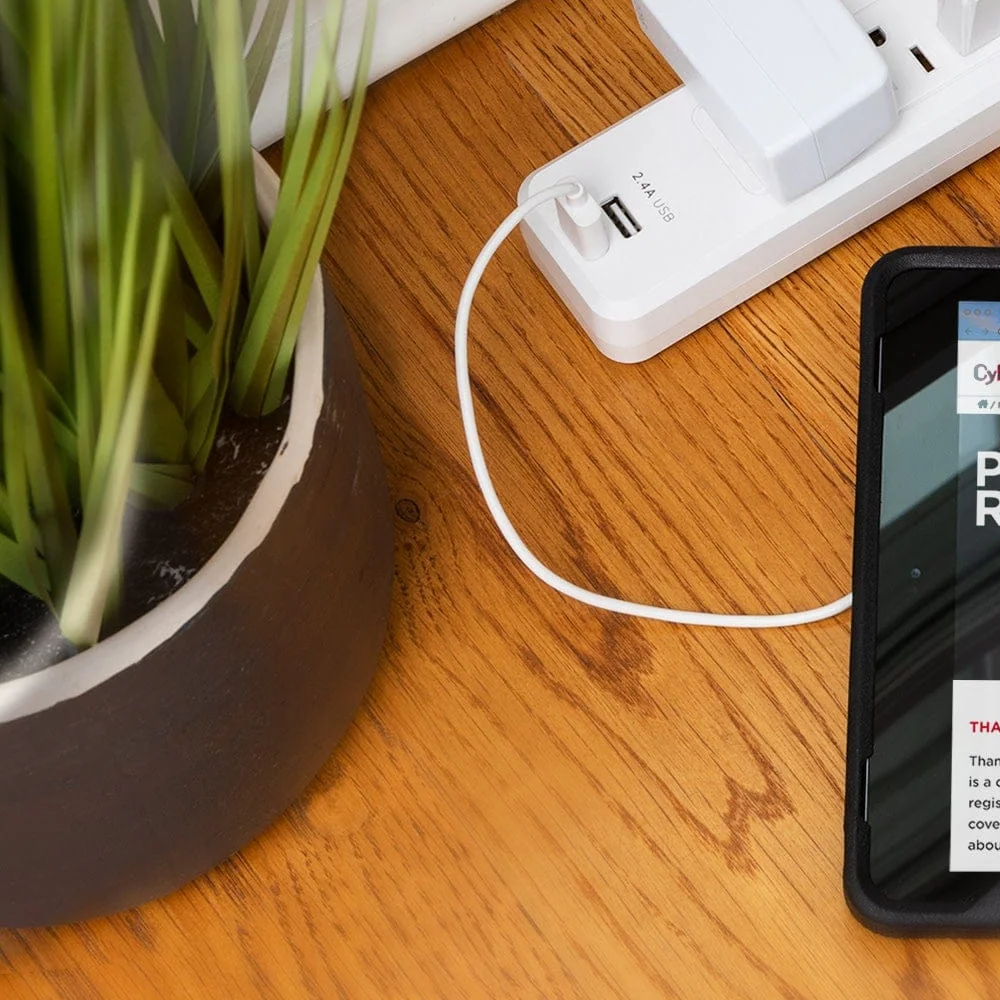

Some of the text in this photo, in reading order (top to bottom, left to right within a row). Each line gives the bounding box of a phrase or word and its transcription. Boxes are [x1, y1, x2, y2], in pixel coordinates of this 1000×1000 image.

[632, 172, 675, 223] 2.4A USB
[969, 777, 979, 788] is
[983, 779, 991, 788] a
